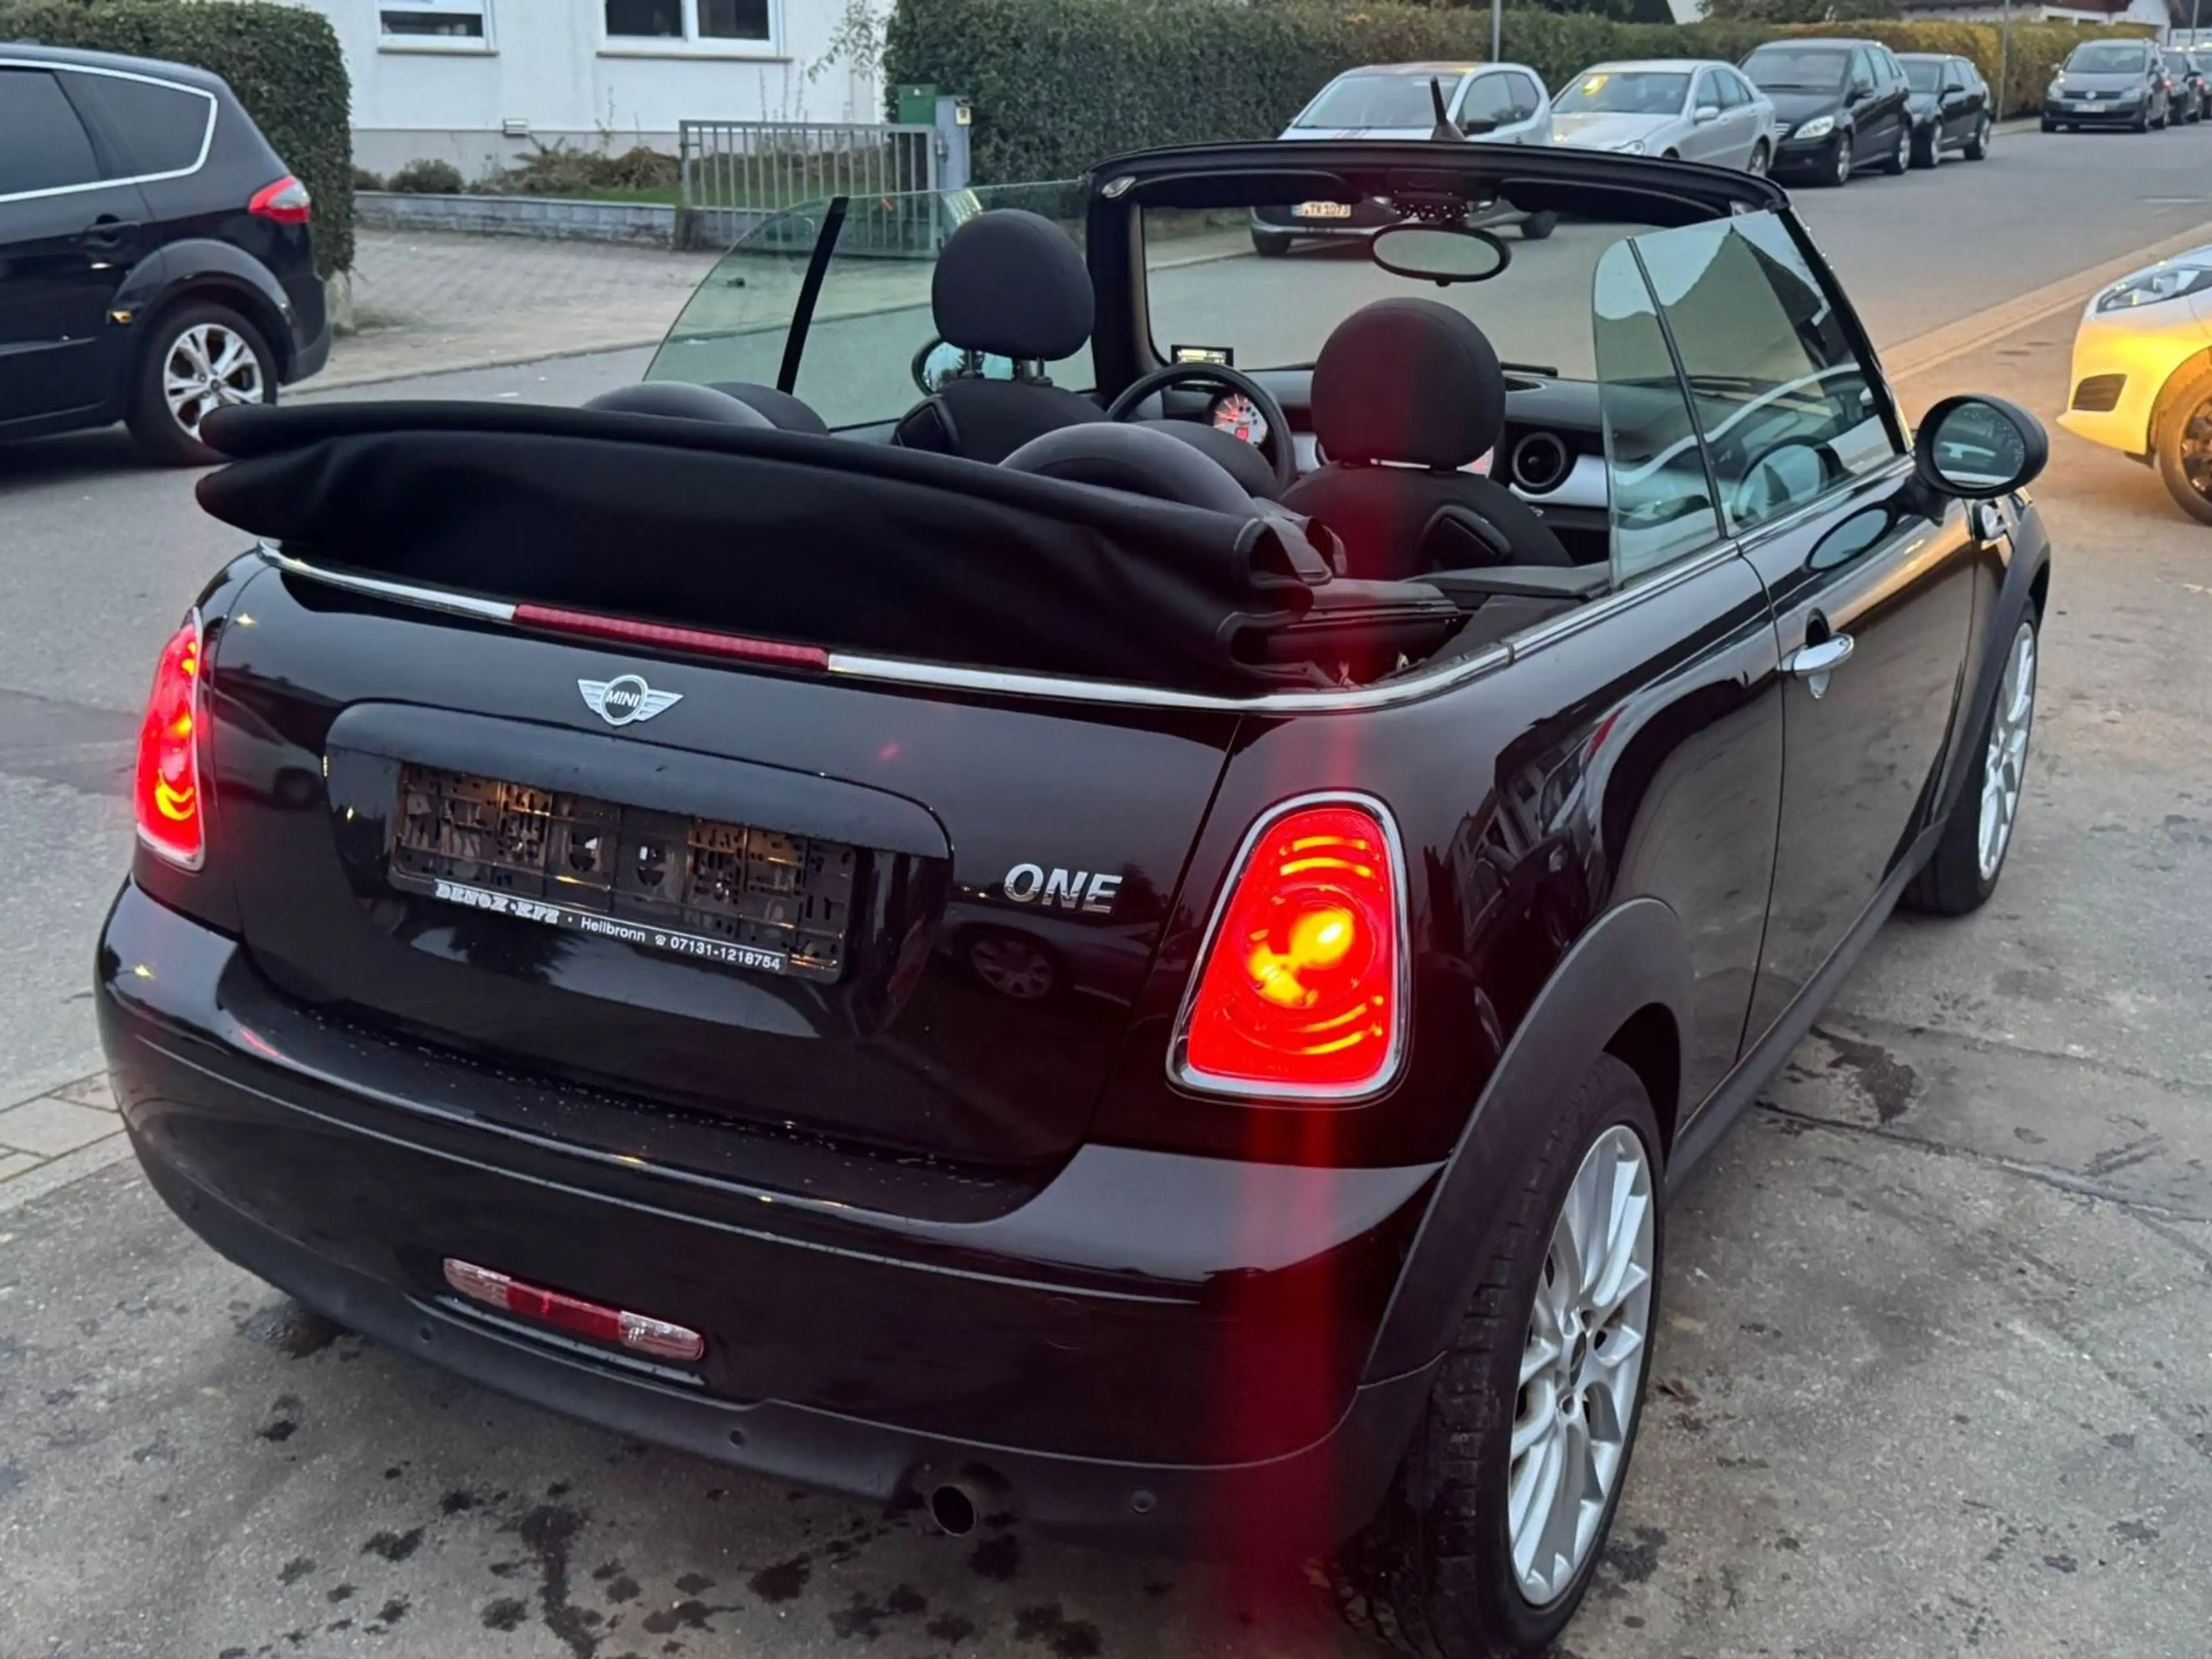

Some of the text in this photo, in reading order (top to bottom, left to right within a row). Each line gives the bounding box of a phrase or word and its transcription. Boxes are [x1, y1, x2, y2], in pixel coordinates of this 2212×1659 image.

[605, 690, 640, 708] MINI
[1003, 863, 1123, 914] ONE
[581, 916, 646, 942] Heilbronn
[670, 937, 781, 971] 07131-1218754
